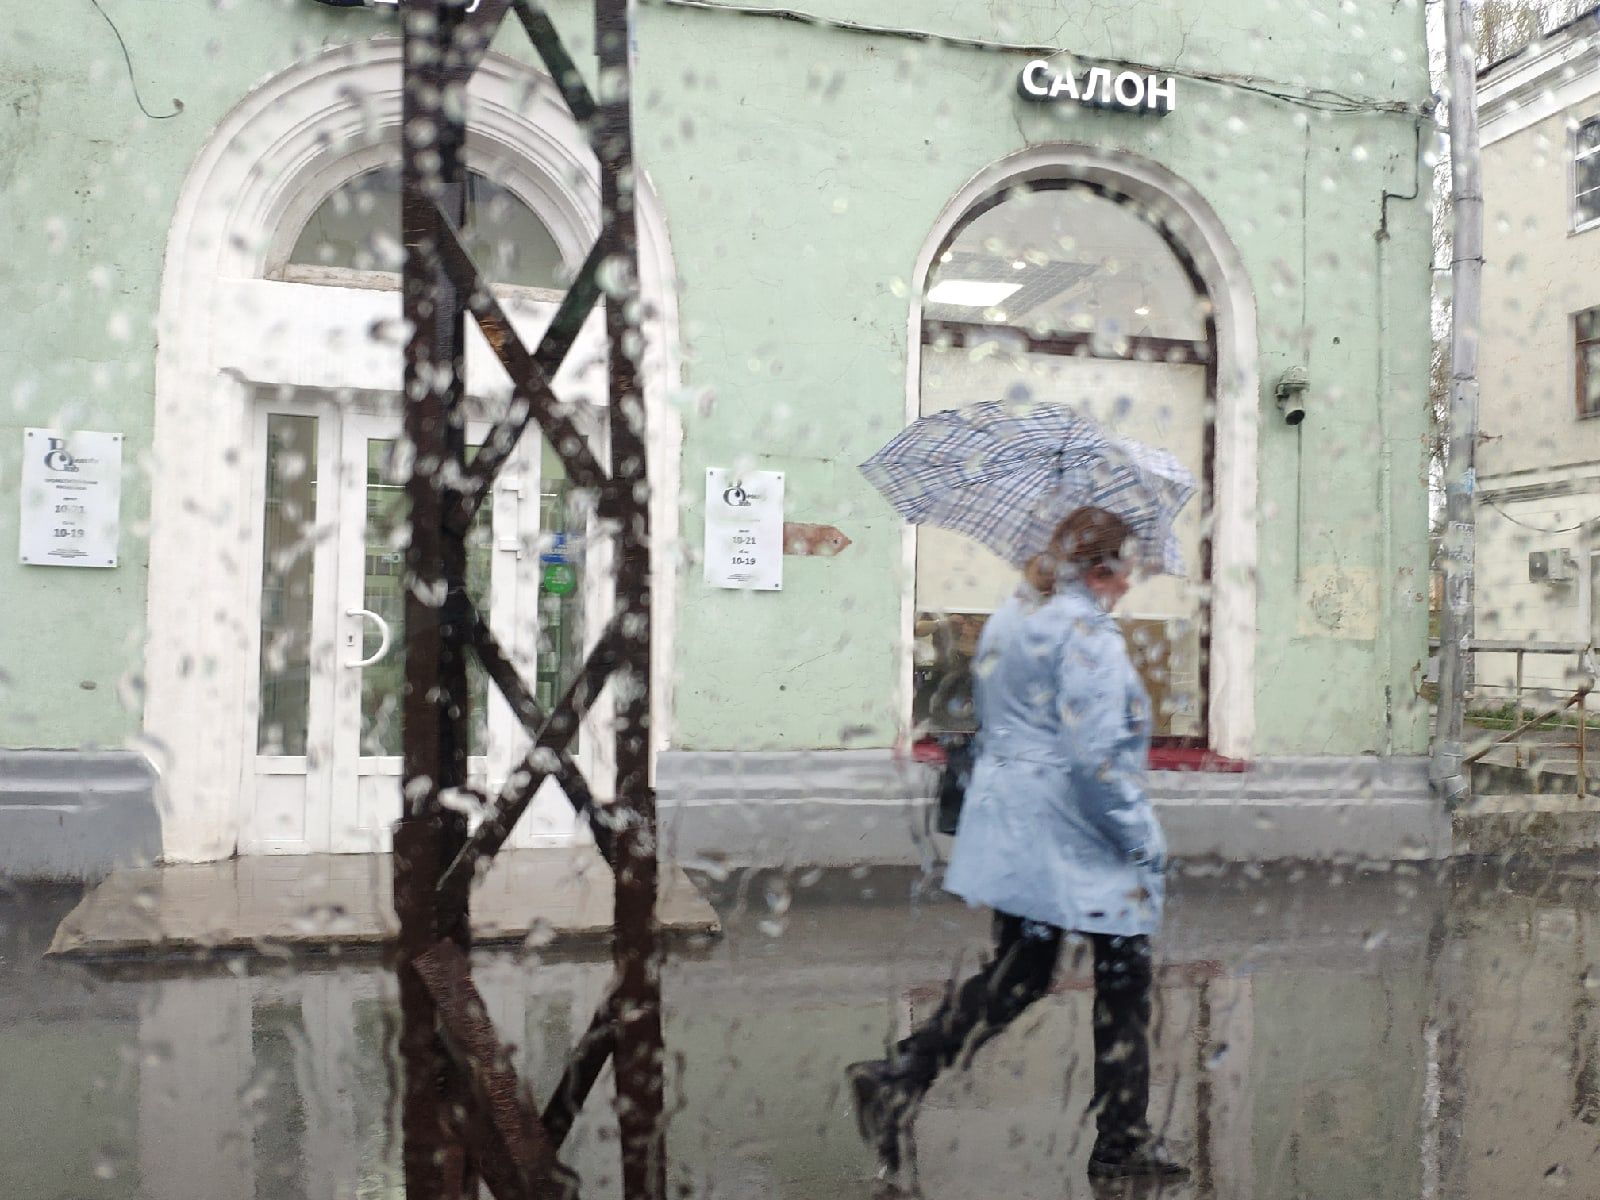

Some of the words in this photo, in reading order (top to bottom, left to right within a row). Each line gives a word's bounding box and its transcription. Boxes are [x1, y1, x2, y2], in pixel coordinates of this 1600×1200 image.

[1022, 60, 1176, 111] САЛОН
[53, 528, 85, 538] 10-19
[732, 536, 757, 545] 10-21
[731, 557, 756, 565] 10-19
